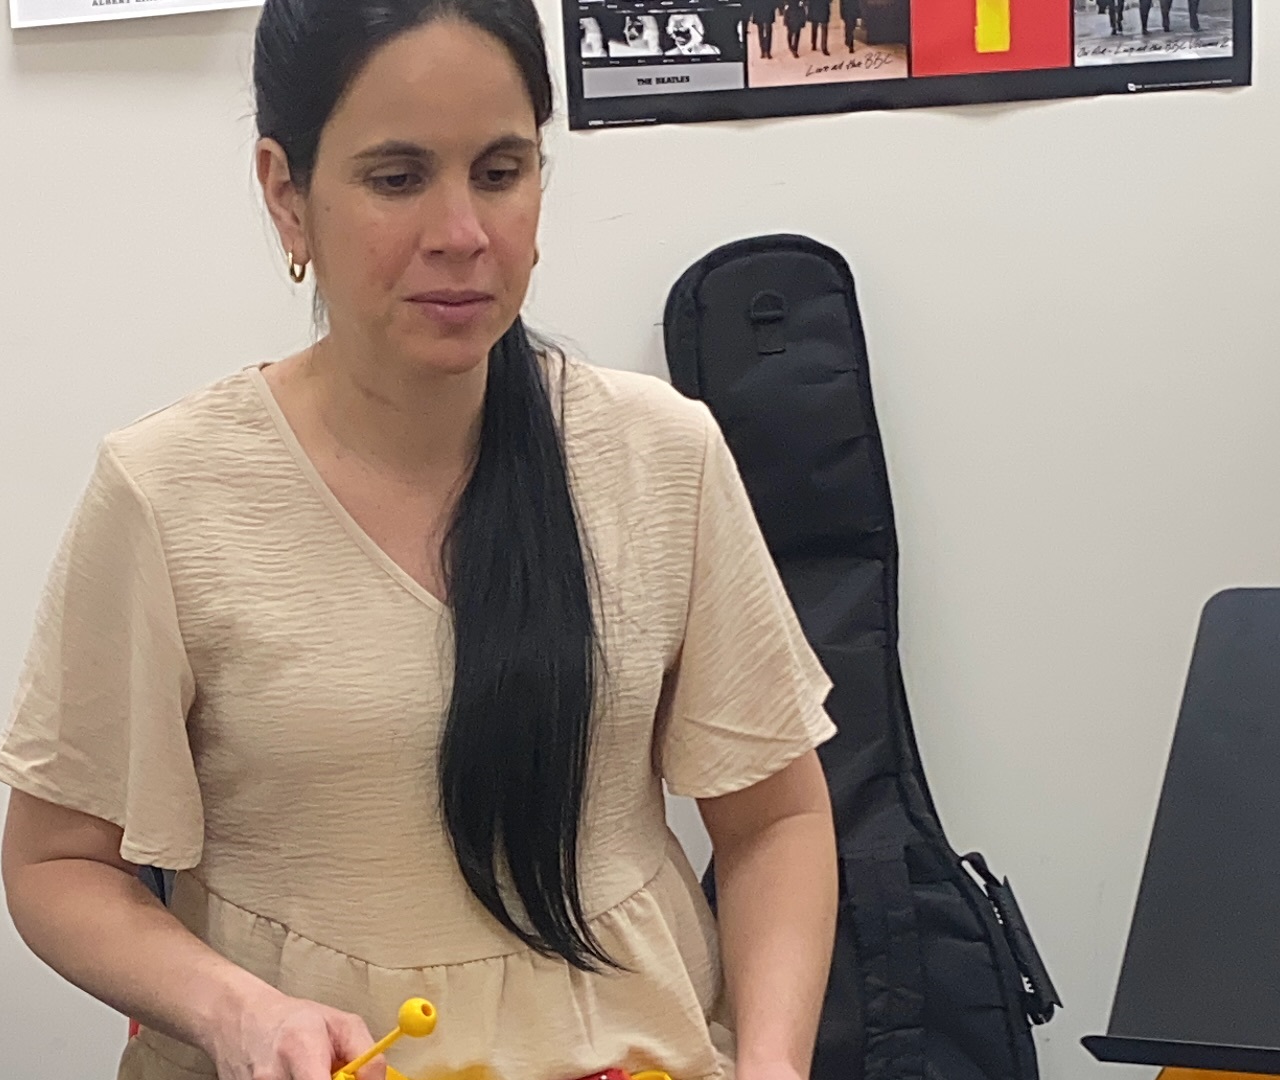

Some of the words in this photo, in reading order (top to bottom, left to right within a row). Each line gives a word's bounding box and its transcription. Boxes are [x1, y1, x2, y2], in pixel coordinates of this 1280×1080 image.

[864, 52, 894, 69] BBC
[637, 78, 652, 86] THE
[655, 75, 690, 85] BEATLES
